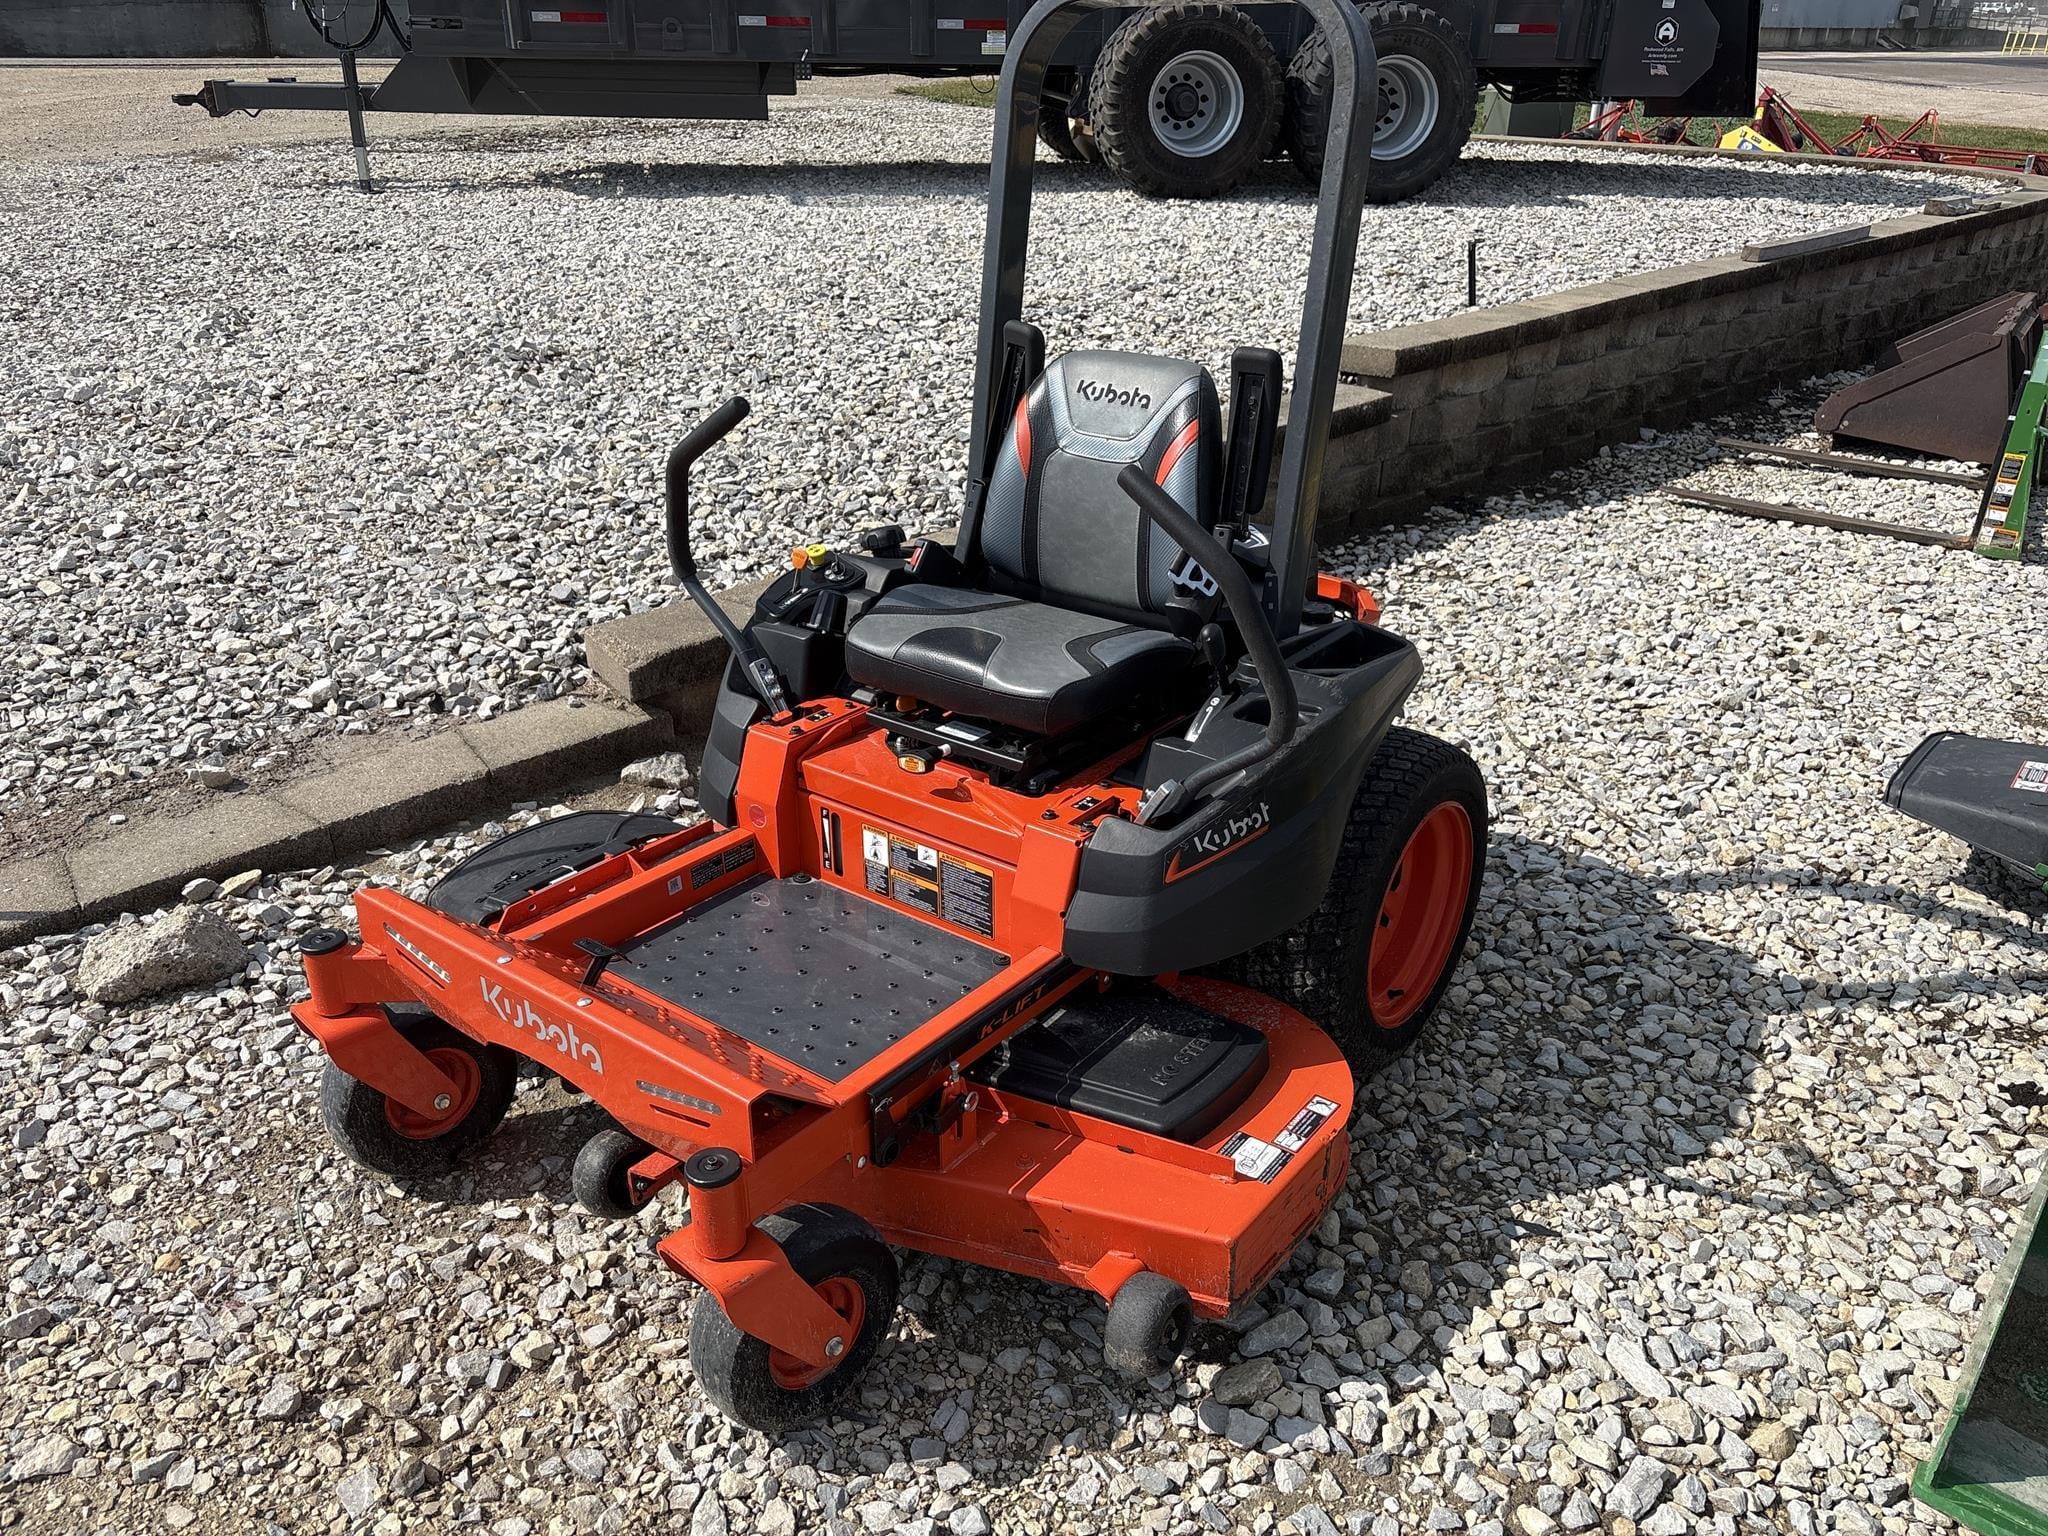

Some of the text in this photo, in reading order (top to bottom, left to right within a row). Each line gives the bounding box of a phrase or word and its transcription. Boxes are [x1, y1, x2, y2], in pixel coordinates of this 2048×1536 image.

[1659, 22, 1675, 40] A
[1076, 379, 1151, 409] Kubota
[1193, 802, 1270, 853] Kubot
[480, 975, 604, 1076] Kubota
[980, 982, 1047, 1040] K-LIFT
[1150, 1063, 1180, 1087] NO
